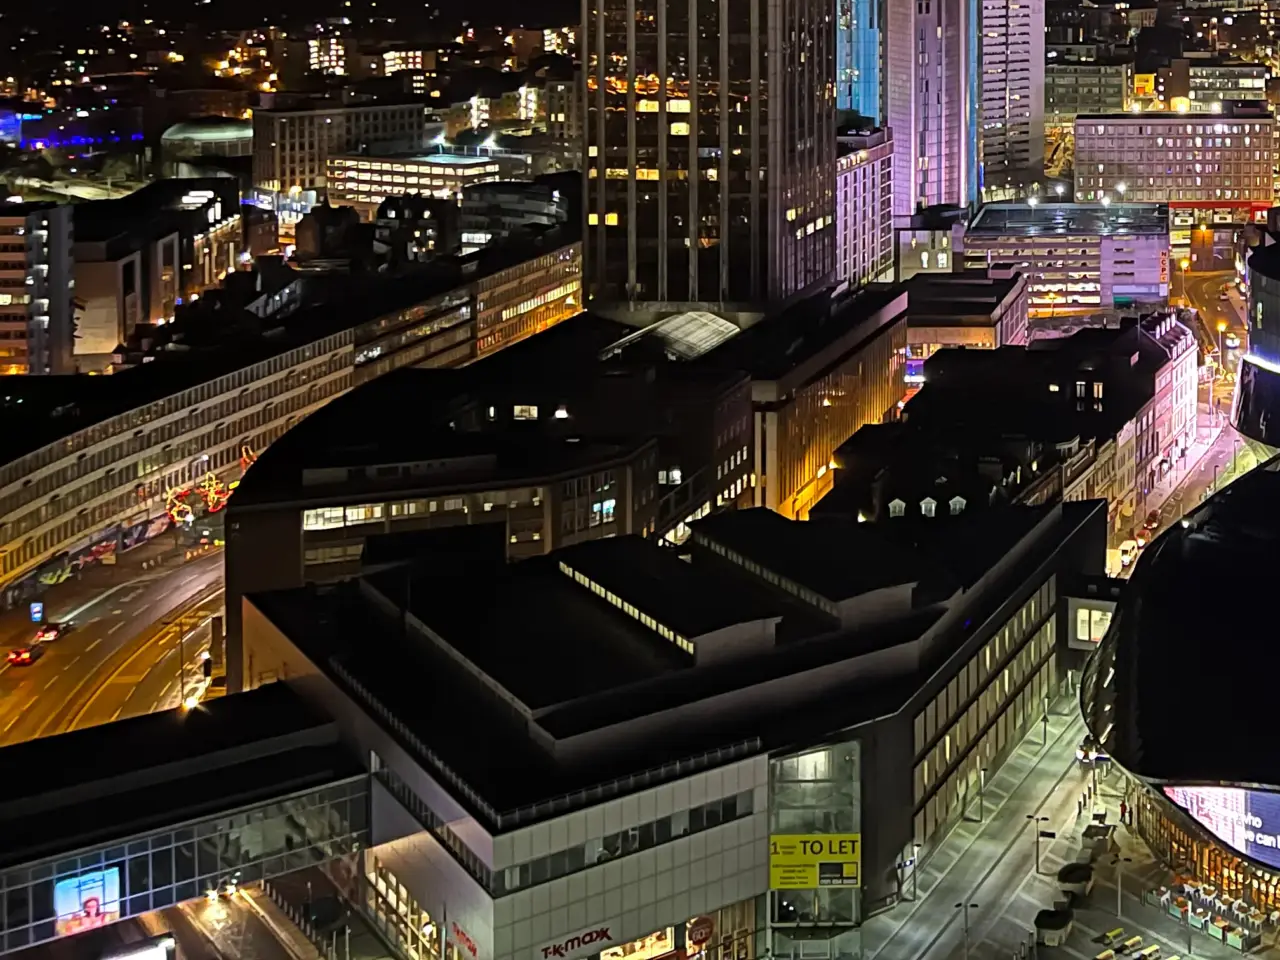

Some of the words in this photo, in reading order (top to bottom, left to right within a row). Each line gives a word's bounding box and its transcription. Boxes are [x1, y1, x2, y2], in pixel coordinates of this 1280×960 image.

[799, 840, 823, 855] TO
[828, 840, 859, 855] LET
[1255, 832, 1276, 848] can
